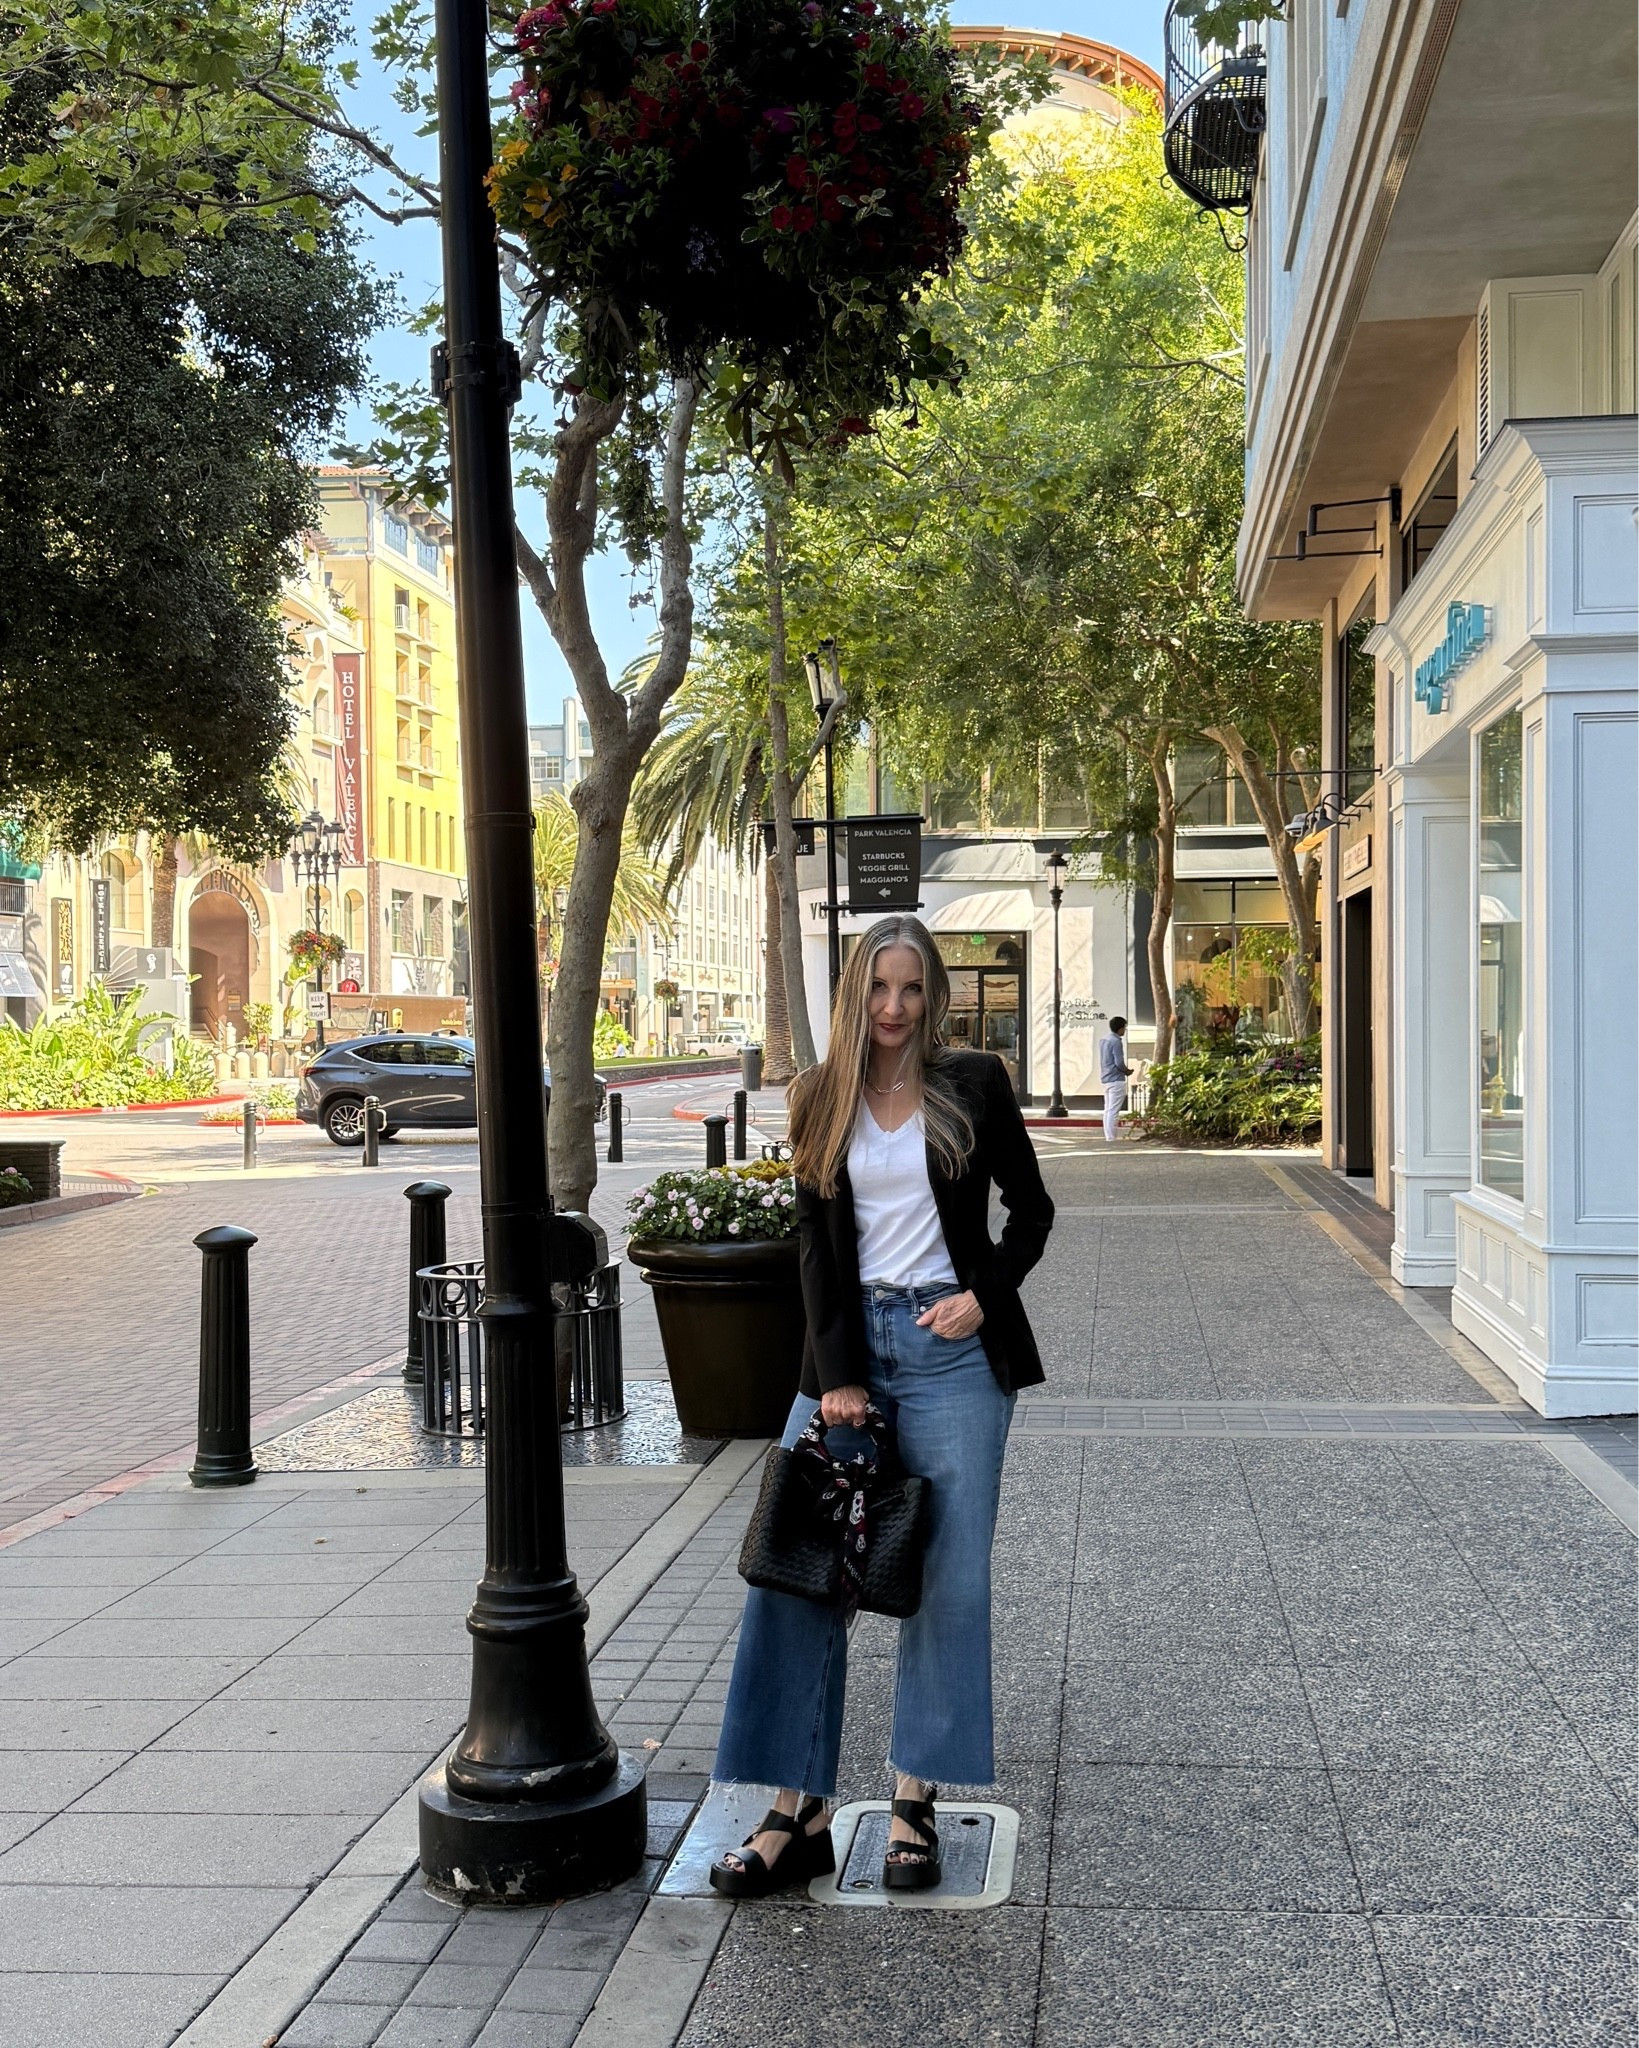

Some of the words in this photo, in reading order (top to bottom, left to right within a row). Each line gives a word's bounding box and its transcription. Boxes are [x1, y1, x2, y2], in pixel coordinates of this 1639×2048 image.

[342, 671, 354, 739] HOTEL
[344, 757, 357, 865] VALENCIA
[854, 830, 874, 838] PARK
[875, 828, 912, 837] VALENCIA
[862, 852, 905, 861] STARBUCKS
[858, 864, 887, 872] VEGGIE
[887, 863, 910, 871] GRILL
[860, 875, 909, 884] MAGGIANO'S
[97, 884, 105, 915] HOTEL
[97, 920, 105, 969] VALENCIA
[310, 995, 325, 1003] KEEP
[310, 1010, 326, 1018] RIGHT
